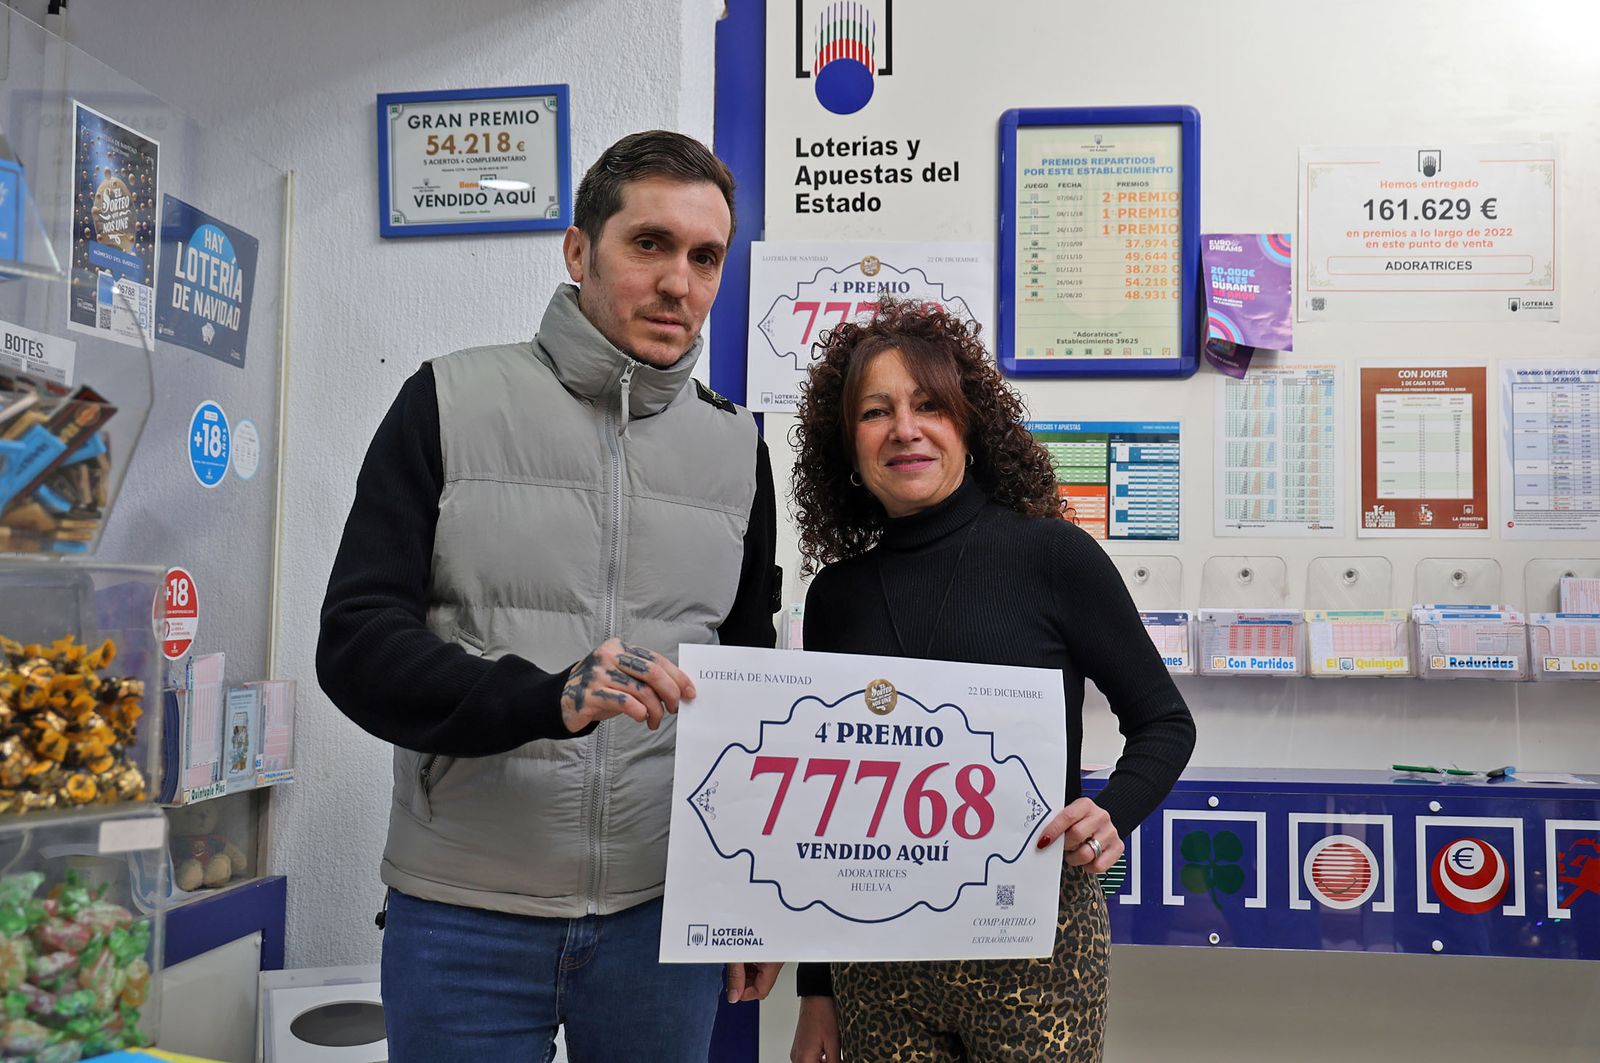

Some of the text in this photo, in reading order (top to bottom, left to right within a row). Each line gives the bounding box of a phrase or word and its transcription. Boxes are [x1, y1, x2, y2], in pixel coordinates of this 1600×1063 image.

[408, 110, 539, 129] GRAN PREMIO
[426, 132, 526, 156] 54.218 €
[796, 136, 920, 160] Loterías y
[428, 158, 460, 166] ACIERTOS
[466, 155, 527, 164] COMPLEMENTARIO
[1042, 157, 1156, 166] PREMIOS REPARTIDOS
[794, 161, 959, 190] Apuestas del
[1024, 166, 1174, 176] POR ESTE ESTABLECIMIENTO
[1380, 179, 1480, 190] Hemos entregado
[102, 188, 130, 213] SORTEO
[414, 187, 536, 208] VENDIDO AQUÍ
[796, 192, 882, 213] Estado
[1118, 192, 1179, 203] PREMIO
[1118, 208, 1179, 219] PREMIO
[1363, 198, 1498, 221] 161.629 €
[102, 217, 128, 234] NOS UNE
[1118, 224, 1179, 235] PREMIO
[1363, 229, 1408, 240] premios
[1410, 230, 1418, 238] a
[1420, 229, 1430, 238] lo
[1434, 228, 1462, 240] largo
[1466, 228, 1480, 237] de
[1484, 228, 1513, 237] 2022
[204, 228, 224, 254] HAY
[1126, 240, 1168, 248] 37.974
[1382, 240, 1406, 248] este
[1408, 240, 1442, 250] punto
[1446, 240, 1460, 248] de
[1462, 240, 1494, 248] venta
[1125, 252, 1168, 260] 49.644
[1125, 264, 1168, 274] 38.782
[1385, 261, 1473, 270] ADORATRICES
[175, 242, 242, 303] LOTERÍA
[844, 281, 910, 294] PREMIO
[1125, 278, 1168, 286] 54.218
[1212, 281, 1260, 293] DURANTE
[1124, 290, 1167, 300] 48.931
[172, 282, 240, 331] DE NAVIDAD
[5, 333, 44, 358] BOTES
[1398, 370, 1448, 378] CON JOKER
[194, 422, 222, 458] +18
[1228, 658, 1294, 669] Con Partidos
[1326, 658, 1404, 670] El Quinigol
[1450, 657, 1514, 668] Reducidas
[1572, 660, 1600, 670] Loto
[700, 670, 812, 685] LOTERÍA DE NAVIDAD
[968, 686, 1044, 699] 22 DE DICIEMBRE
[836, 722, 944, 747] PREMIO
[750, 756, 996, 840] 77768
[796, 840, 949, 866] VENDIDO AQUÍ
[837, 868, 907, 878] ADORATRICES
[851, 882, 892, 892] HUELVA
[972, 918, 1036, 926] COMPARTIRLO
[712, 926, 754, 936] LOTERÍA
[712, 938, 764, 946] NACIONAL
[972, 936, 1034, 944] EXTRAORDINARIO
